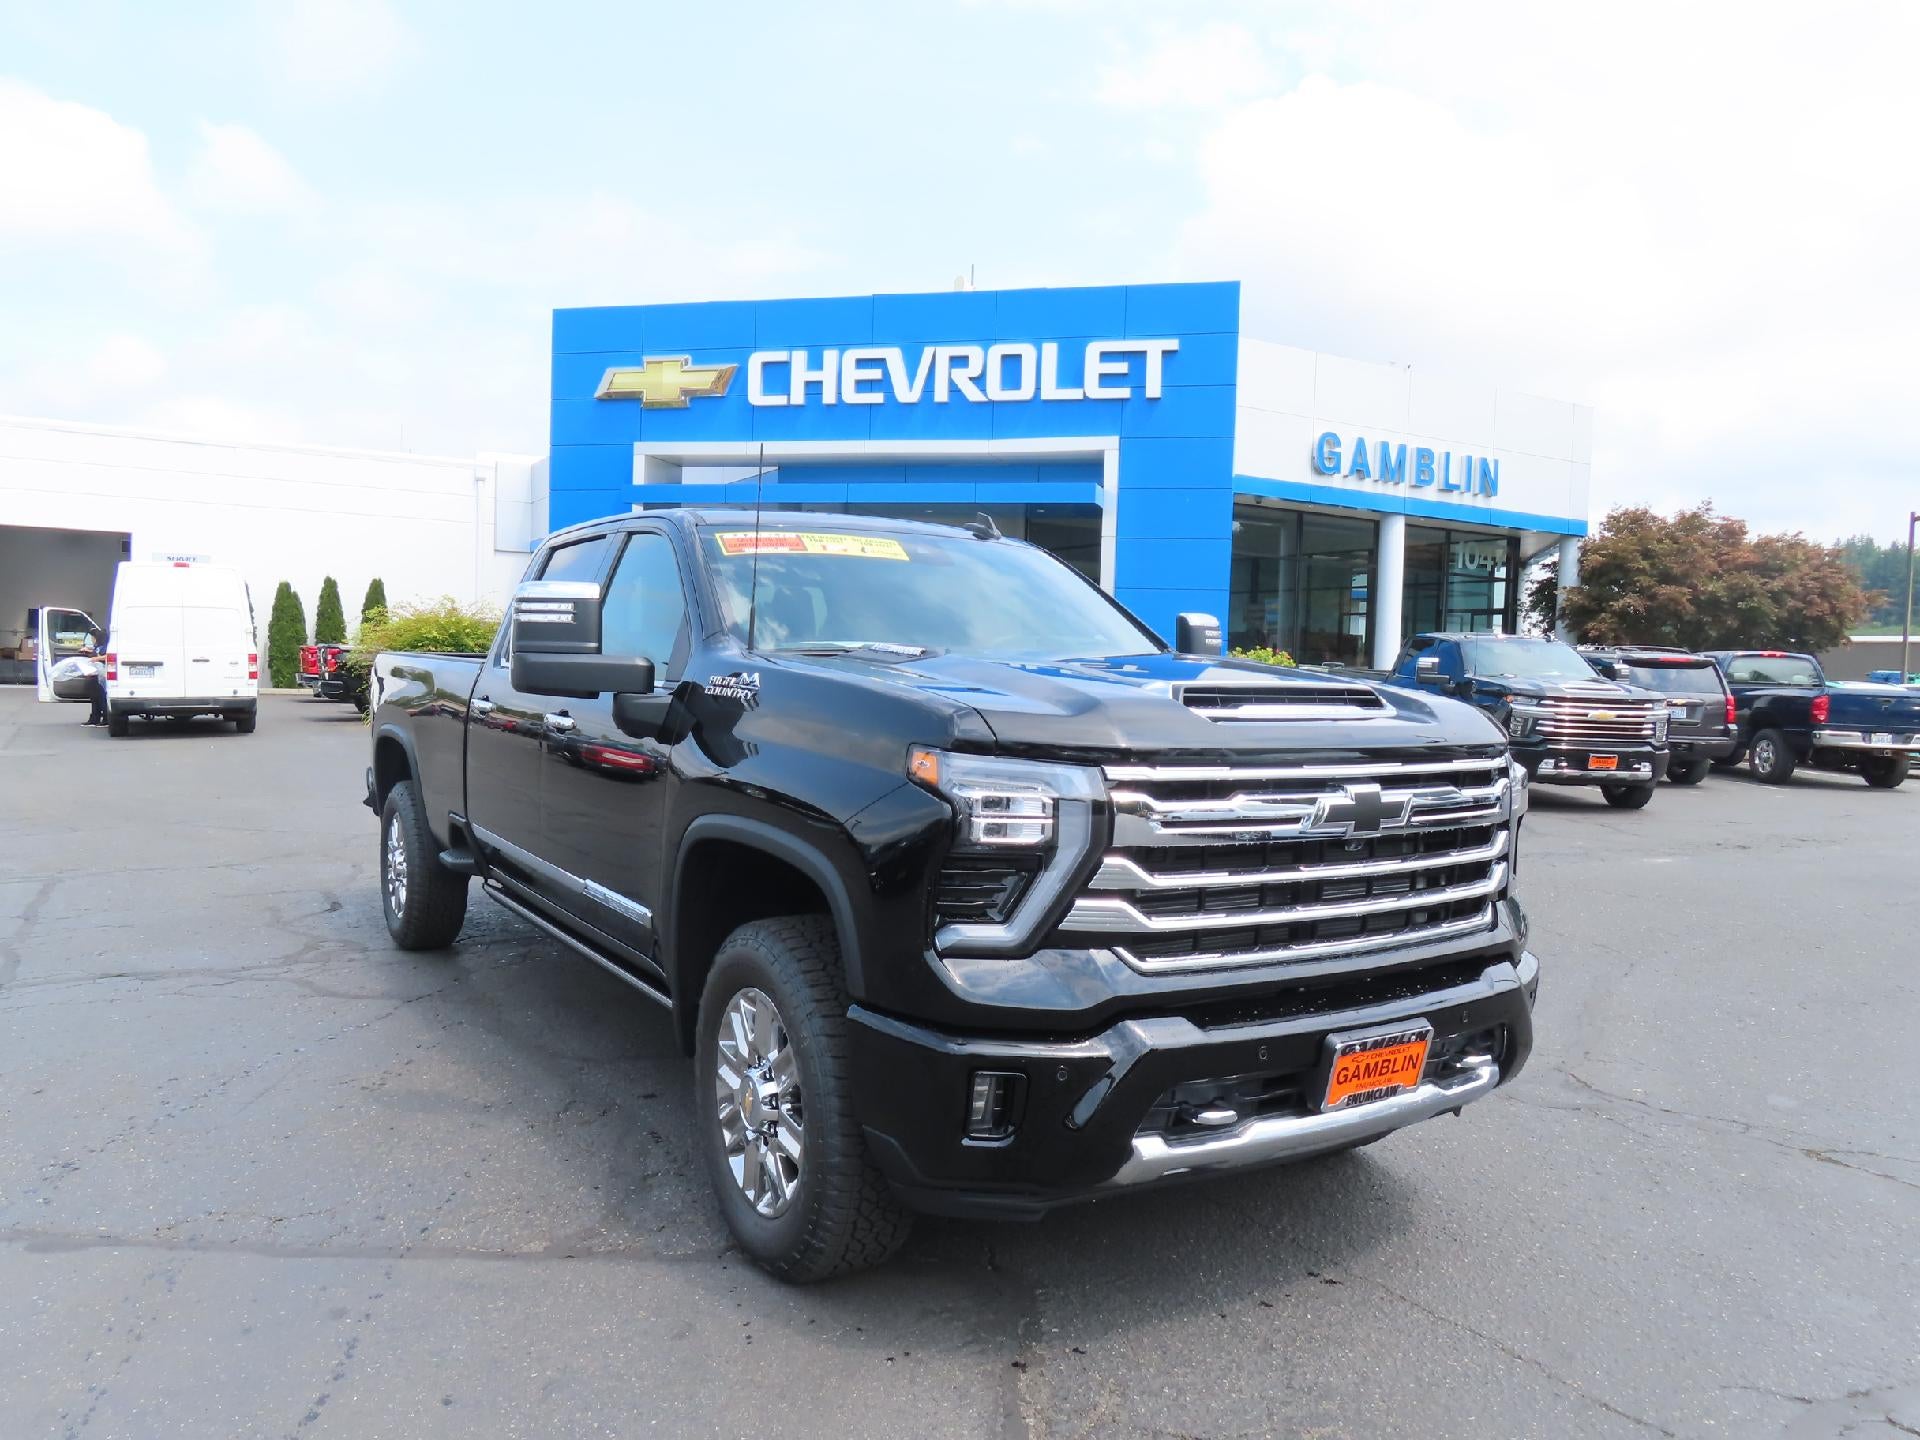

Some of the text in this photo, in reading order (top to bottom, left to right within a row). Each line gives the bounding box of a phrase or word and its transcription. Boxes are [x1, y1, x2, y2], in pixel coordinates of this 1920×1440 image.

[747, 339, 1179, 405] CHEVROLET
[1313, 432, 1499, 497] GAMBLIN
[704, 686, 753, 699] COUNTRY
[1370, 1046, 1411, 1059] CHEVROLET
[1336, 1053, 1420, 1085] GAMBLIN
[1346, 1085, 1399, 1106] ENUMCLAW
